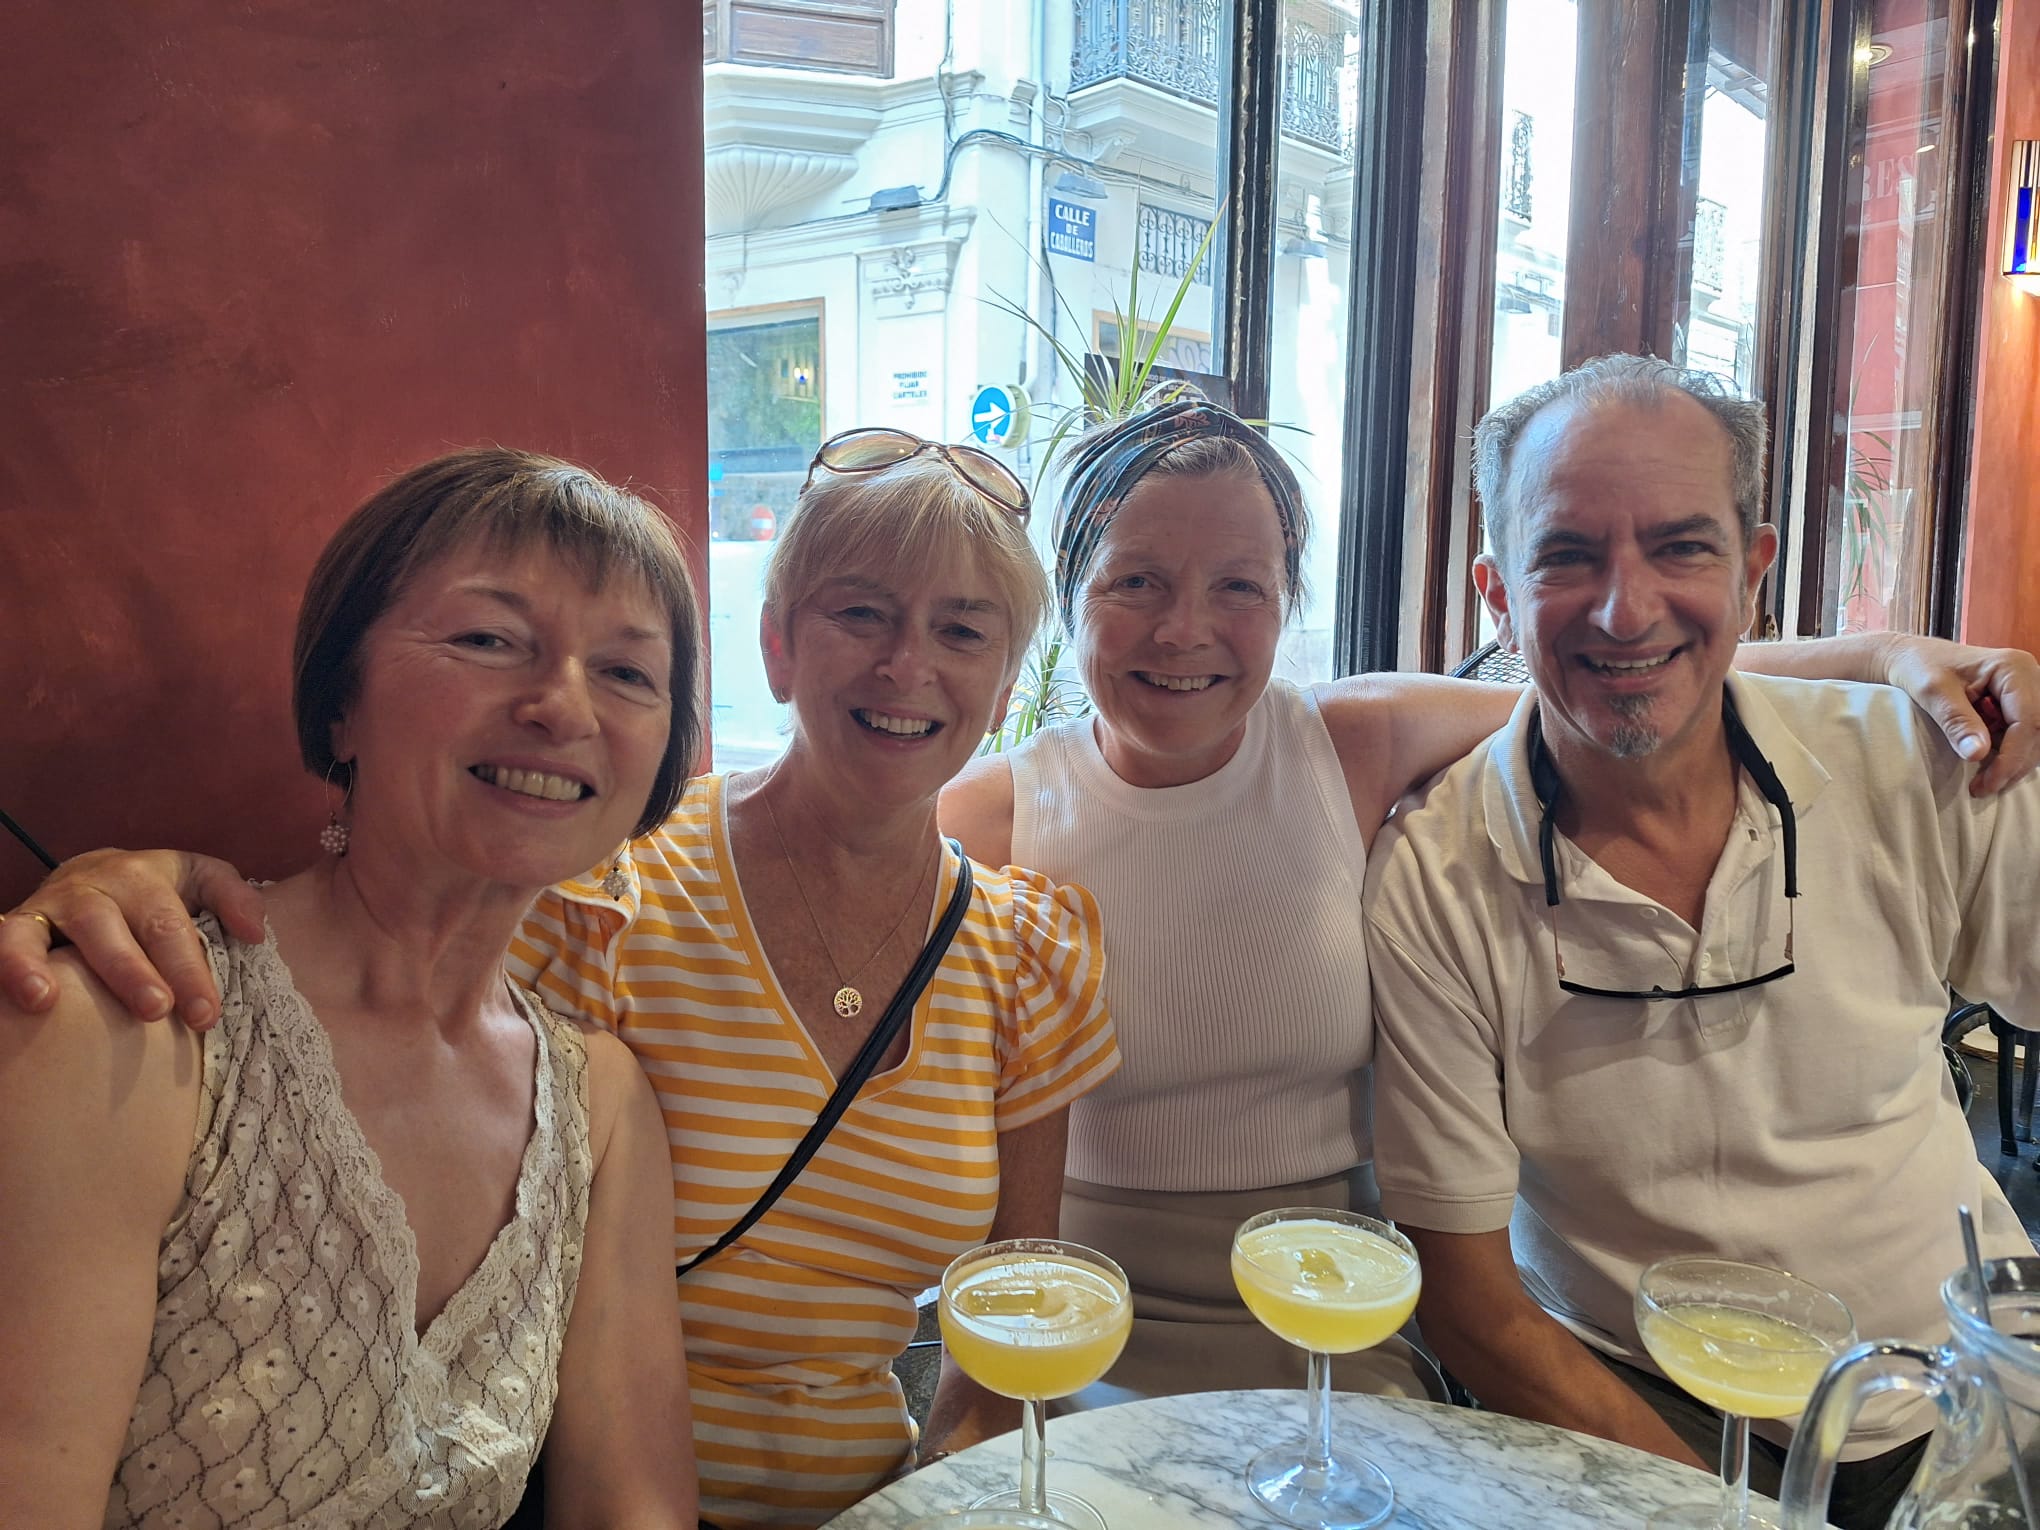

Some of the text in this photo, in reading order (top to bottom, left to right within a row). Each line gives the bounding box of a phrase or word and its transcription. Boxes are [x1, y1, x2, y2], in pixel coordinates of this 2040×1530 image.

[1055, 204, 1090, 226] CALLE
[1066, 223, 1079, 235] DE
[1050, 232, 1094, 258] CABALLEROS
